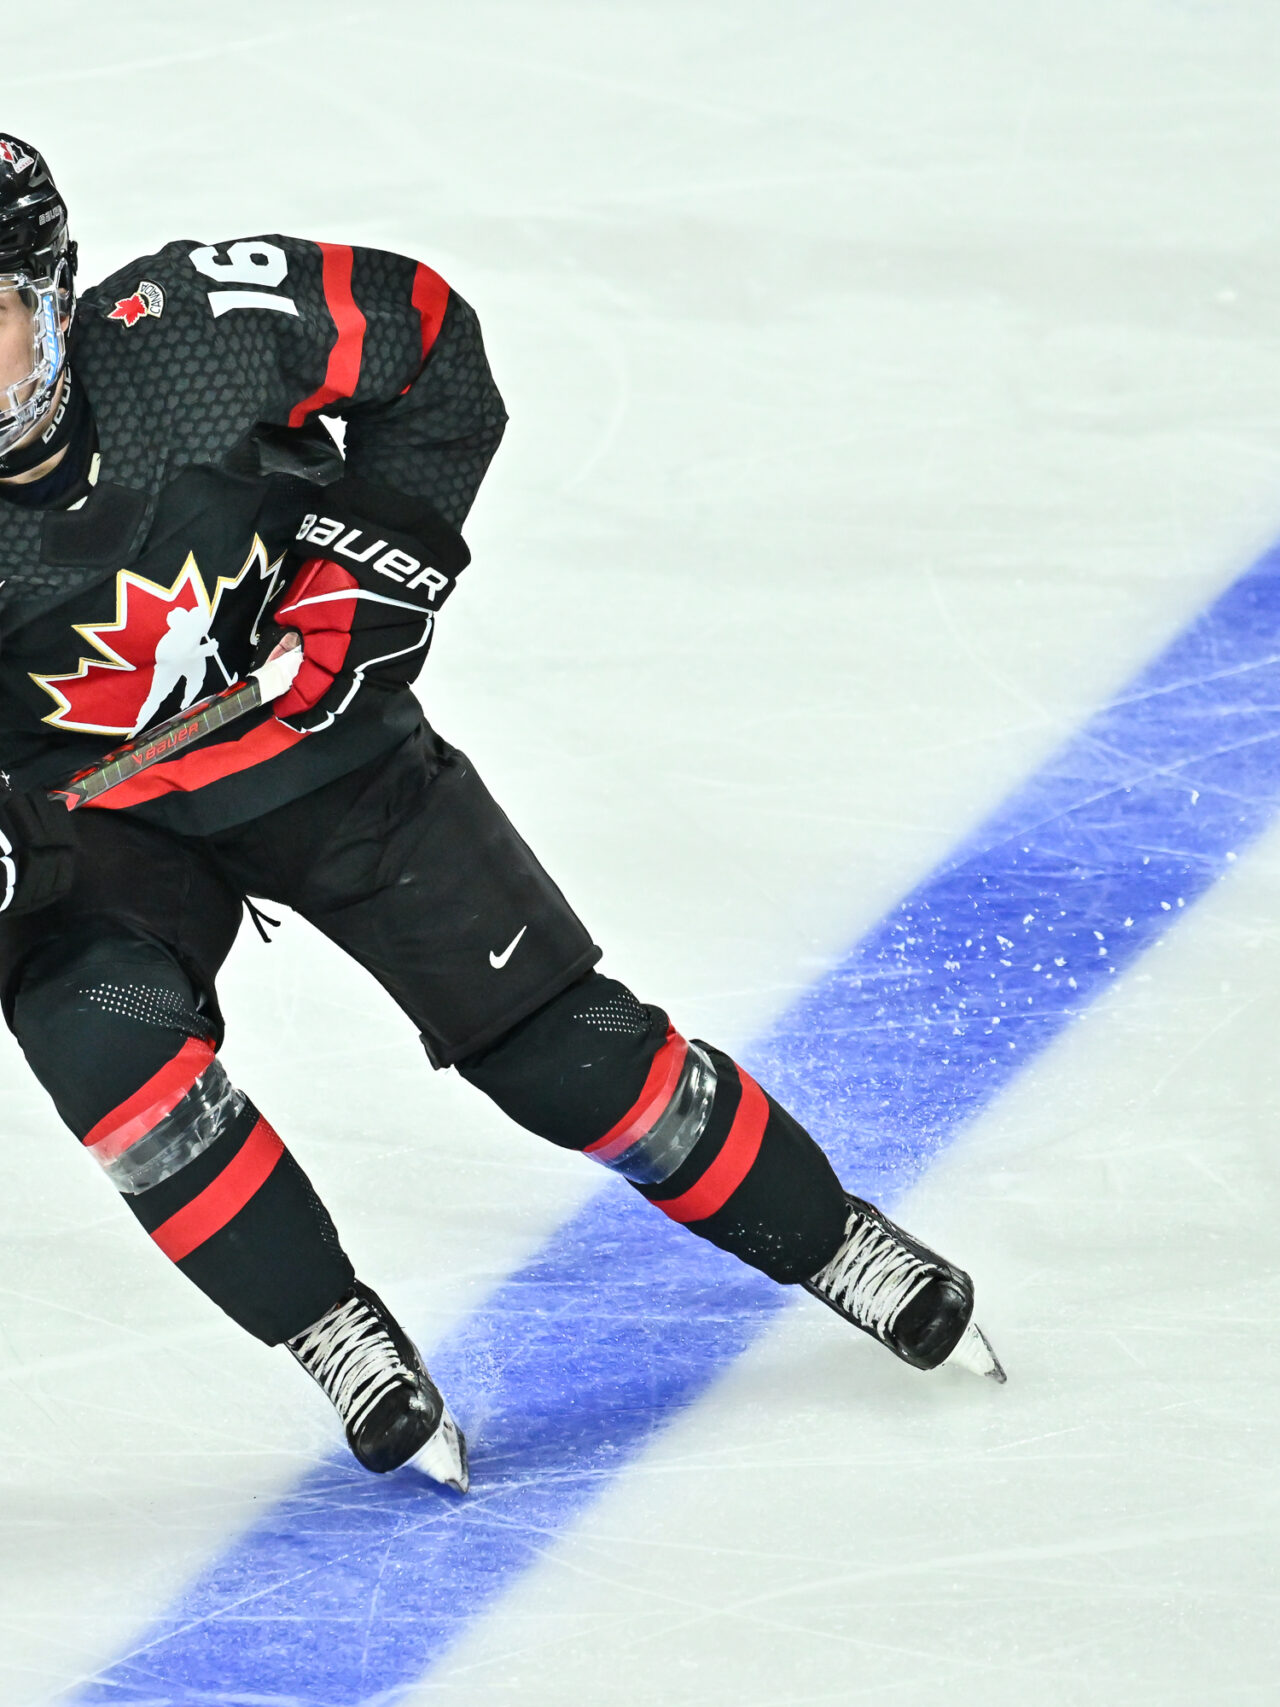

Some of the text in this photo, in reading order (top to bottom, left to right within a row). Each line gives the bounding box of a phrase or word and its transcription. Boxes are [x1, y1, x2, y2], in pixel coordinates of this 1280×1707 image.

[140, 283, 162, 315] CANADA
[188, 241, 300, 318] 16
[295, 513, 449, 602] BAUER
[145, 721, 200, 761] BAUER
